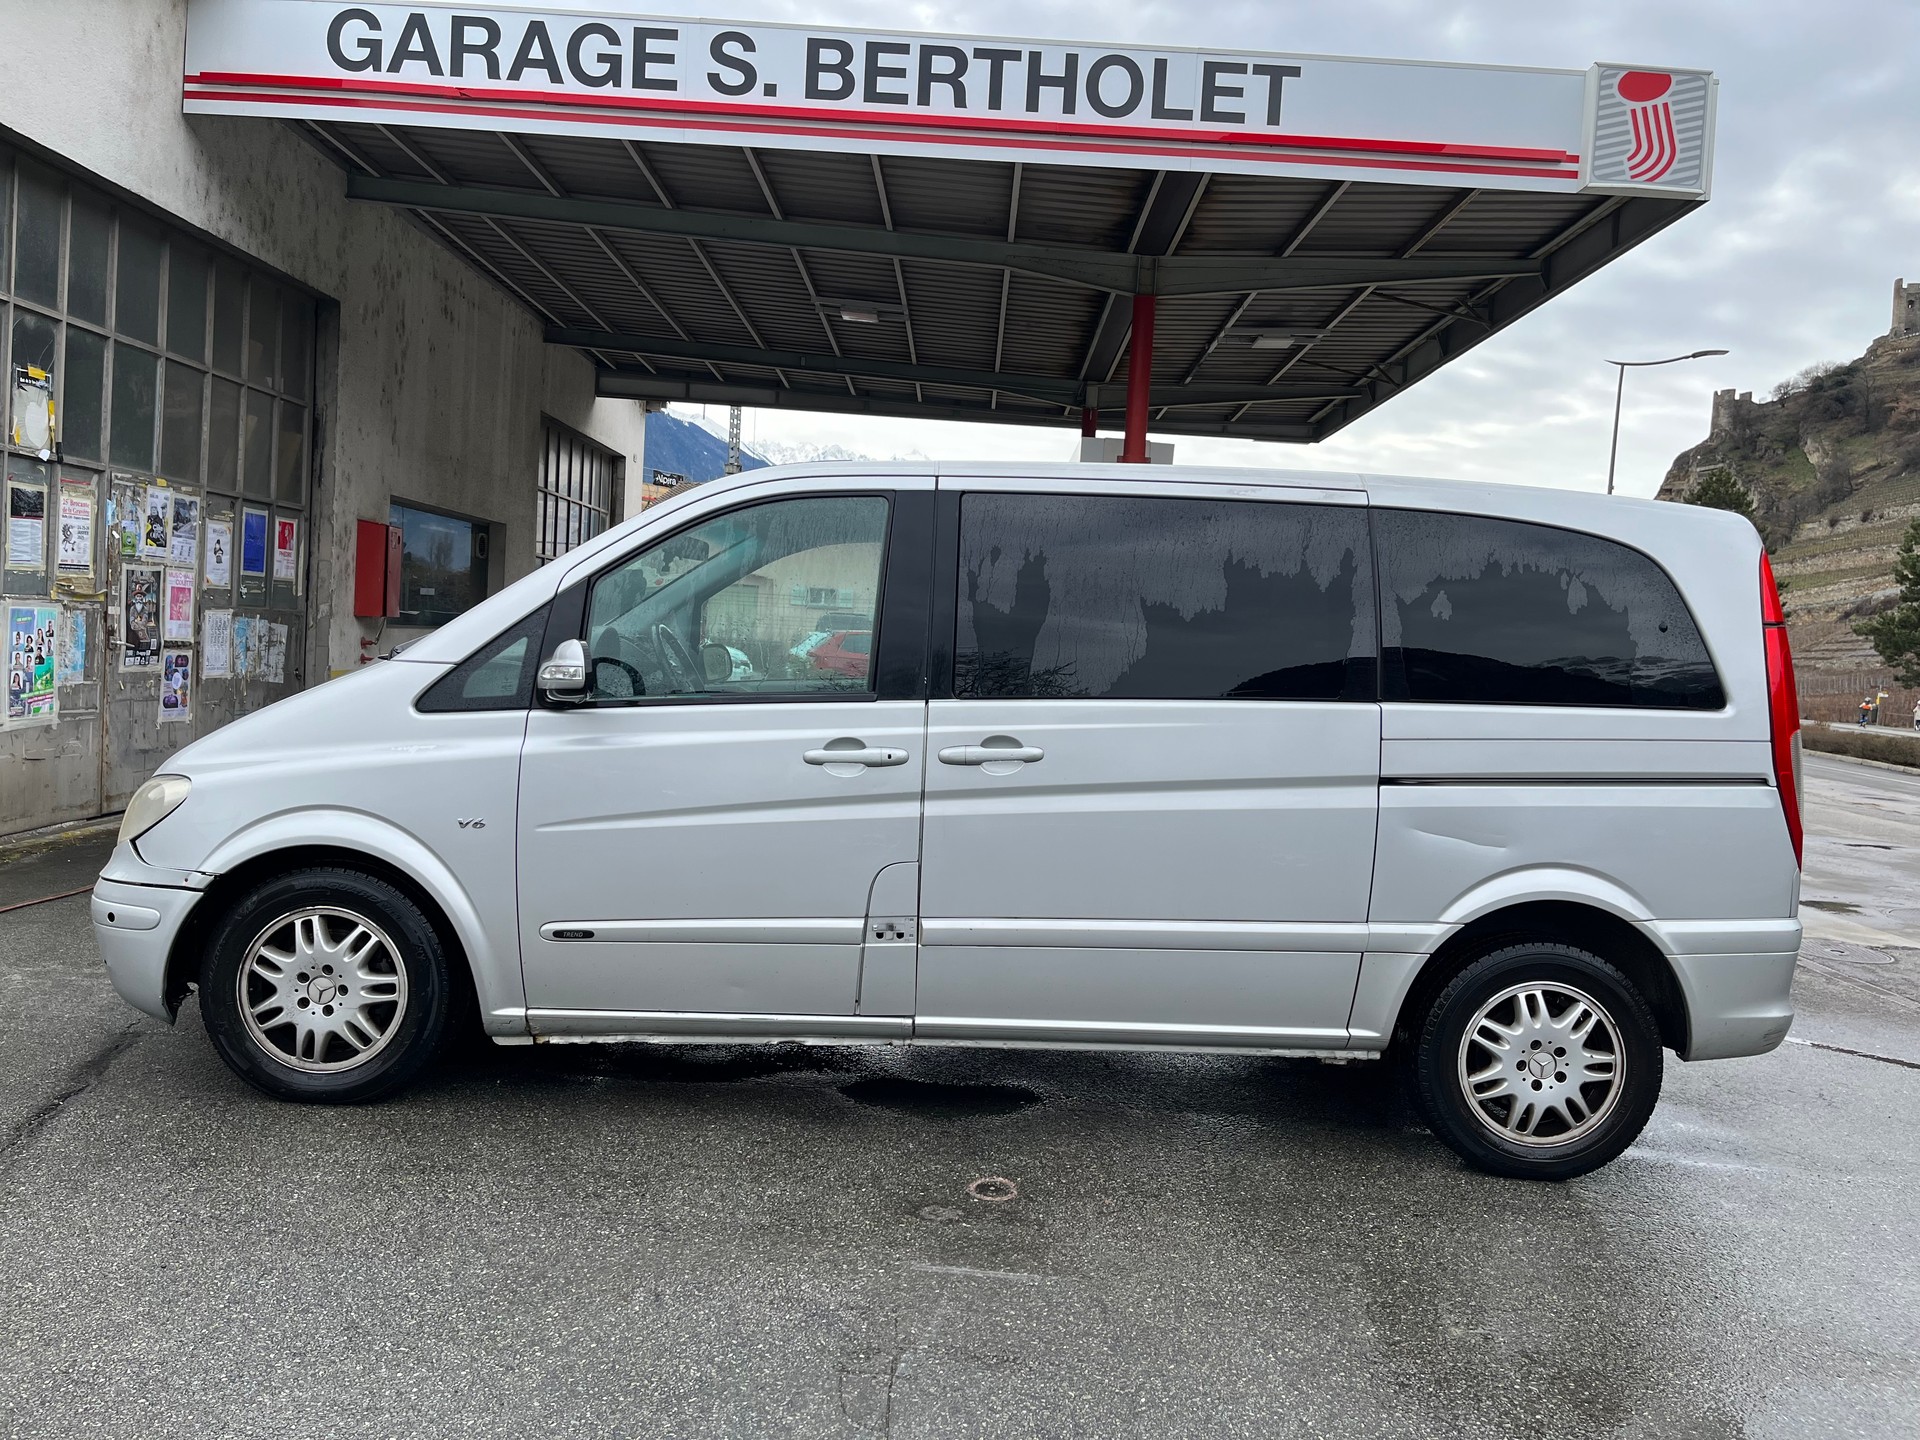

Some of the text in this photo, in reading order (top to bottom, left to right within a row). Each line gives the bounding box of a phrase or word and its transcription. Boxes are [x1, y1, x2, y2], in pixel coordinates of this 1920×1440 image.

[326, 8, 1302, 126] GARAGE S. BERTHOLET
[457, 818, 486, 829] V6
